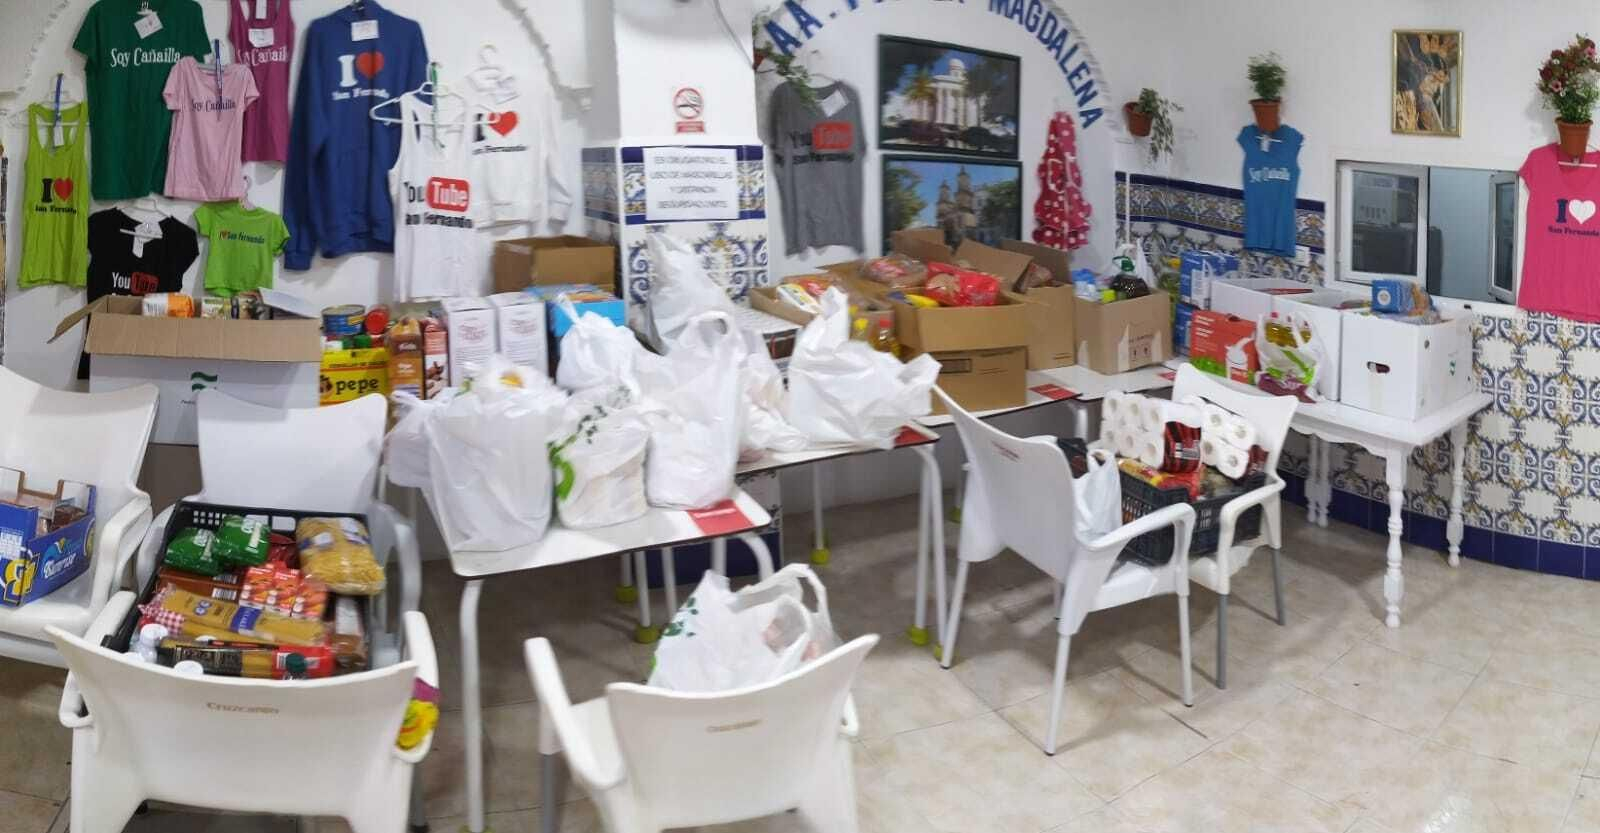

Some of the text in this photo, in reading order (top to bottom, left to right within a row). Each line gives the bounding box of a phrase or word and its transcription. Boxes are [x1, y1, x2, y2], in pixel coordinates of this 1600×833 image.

[111, 48, 131, 68] Soy
[337, 54, 358, 87] I
[41, 177, 53, 203] I
[431, 180, 468, 208] Tube
[1555, 198, 1568, 223] I
[112, 271, 131, 289] You
[335, 378, 380, 396] pepe
